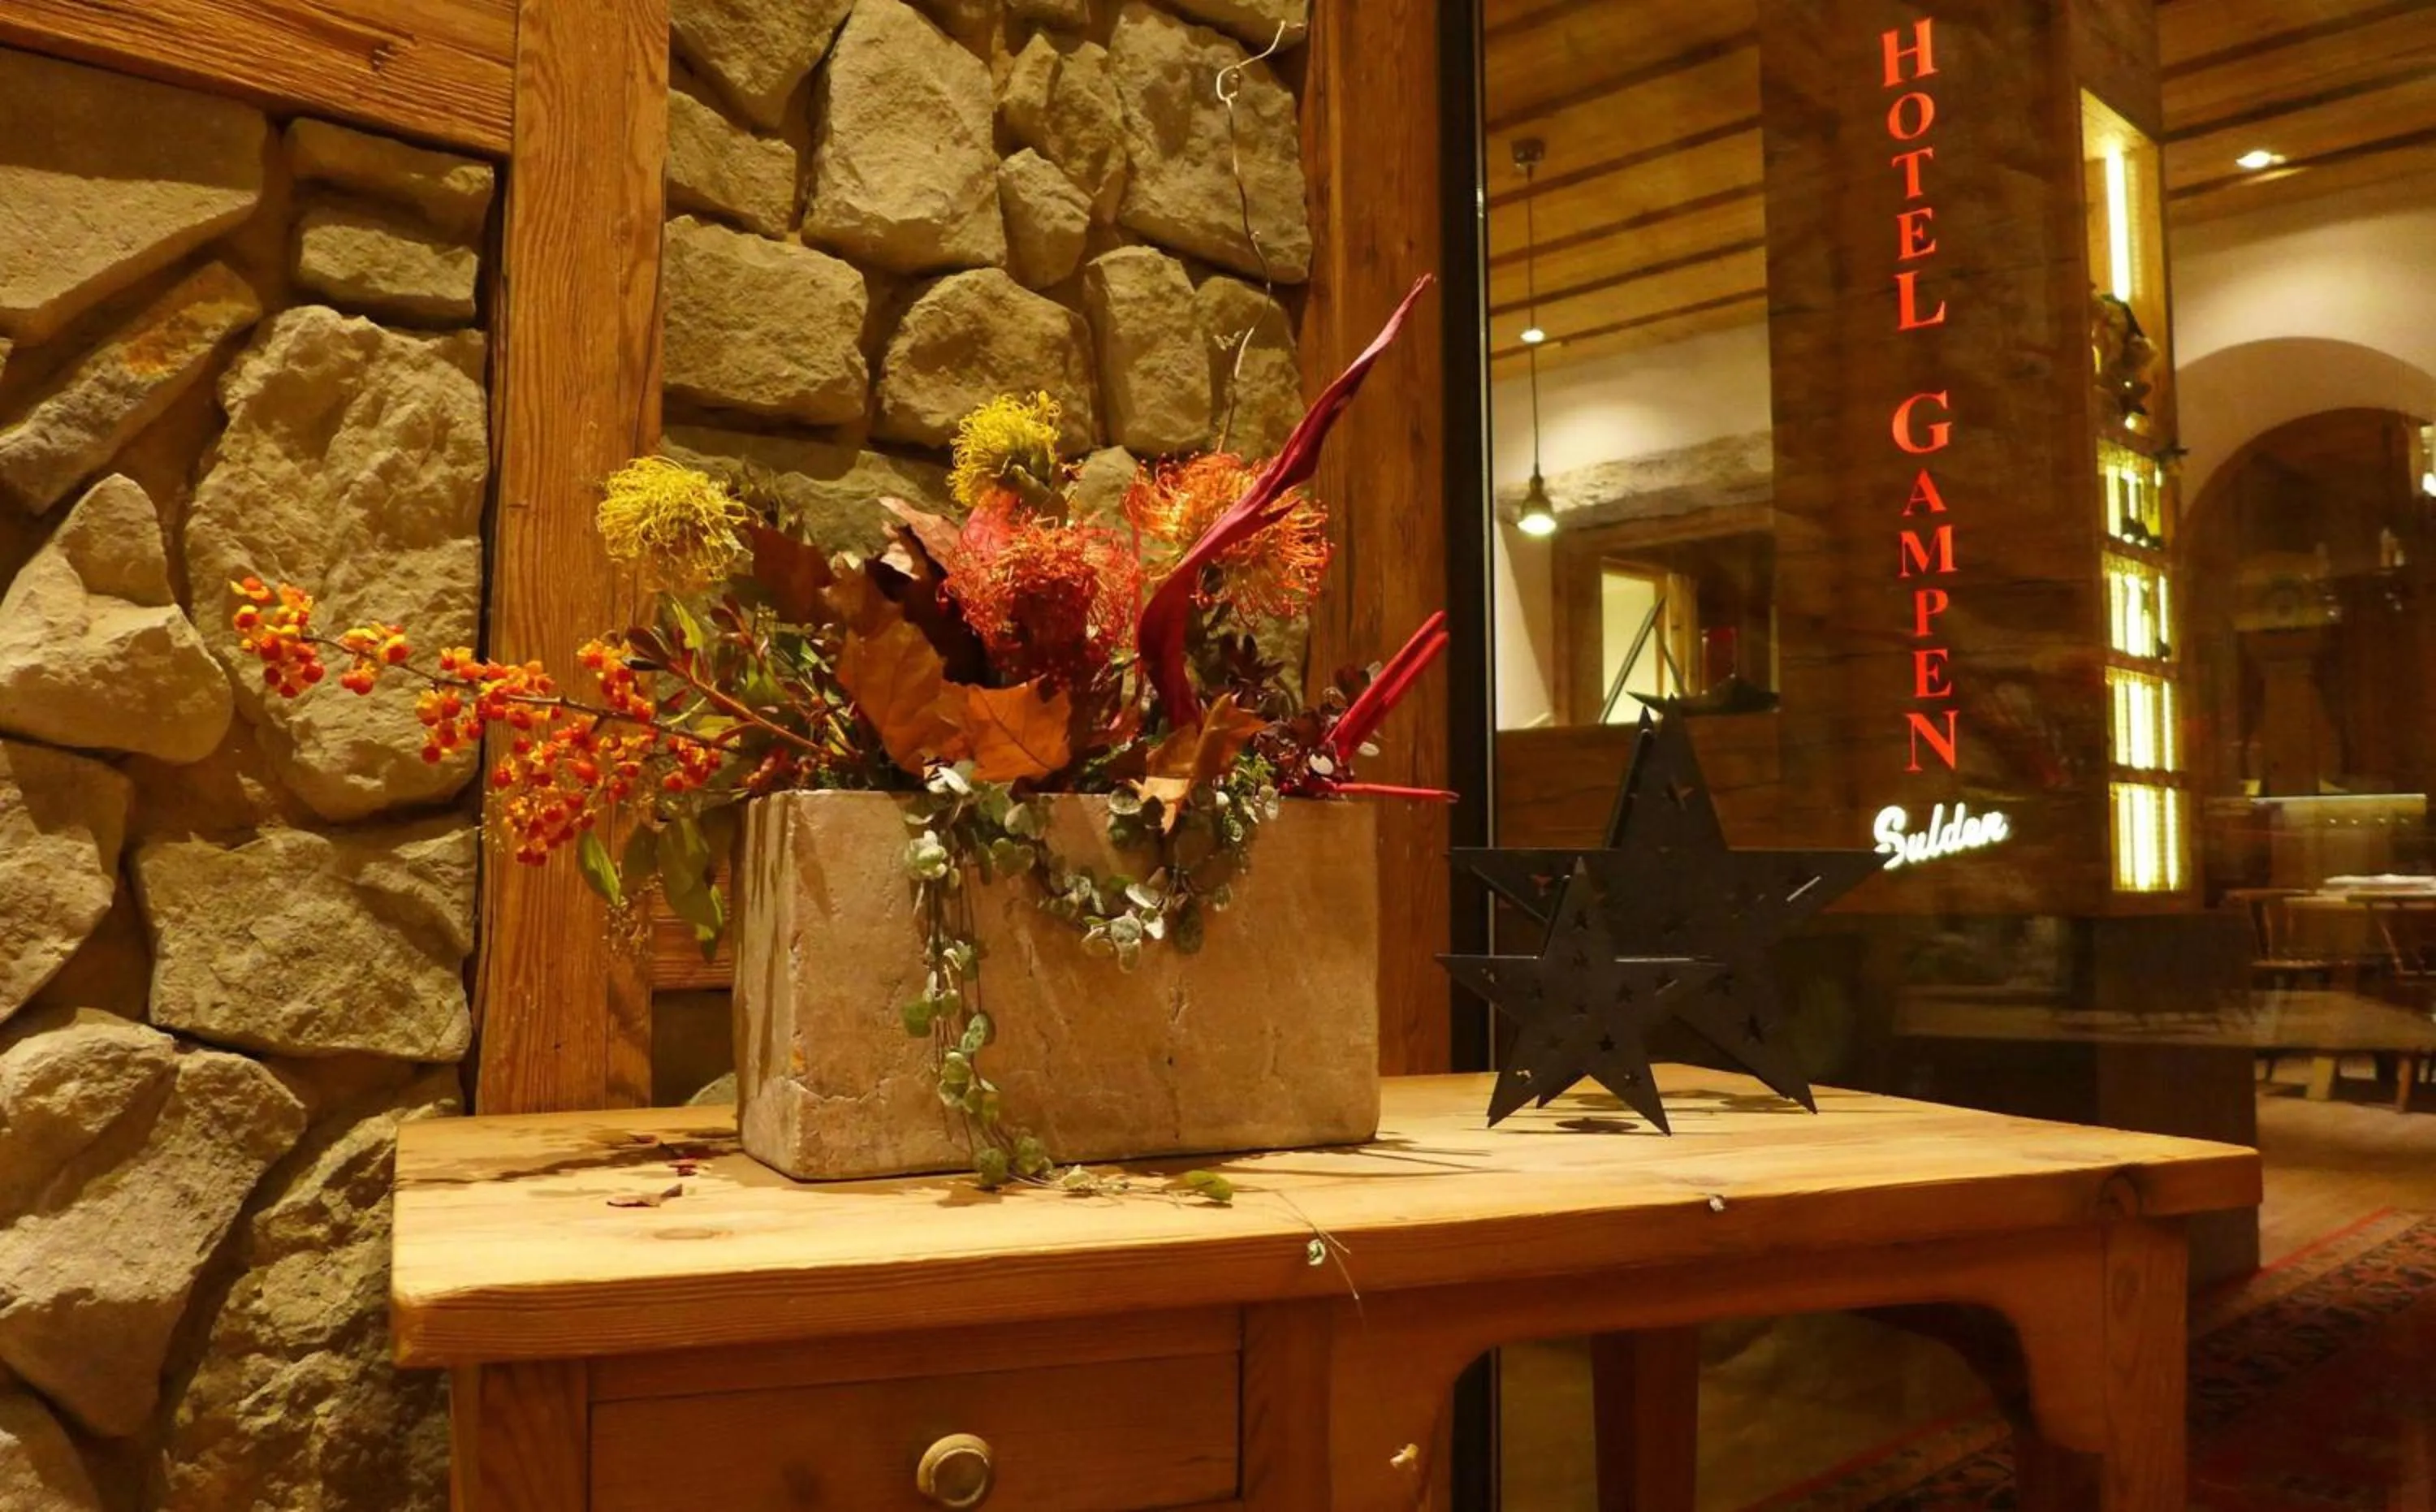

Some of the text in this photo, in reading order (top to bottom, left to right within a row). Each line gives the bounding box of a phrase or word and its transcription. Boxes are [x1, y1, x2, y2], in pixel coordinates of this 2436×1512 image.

[1881, 16, 1960, 773] HOTEL GAMPEN
[1873, 801, 2010, 870] Sulden
